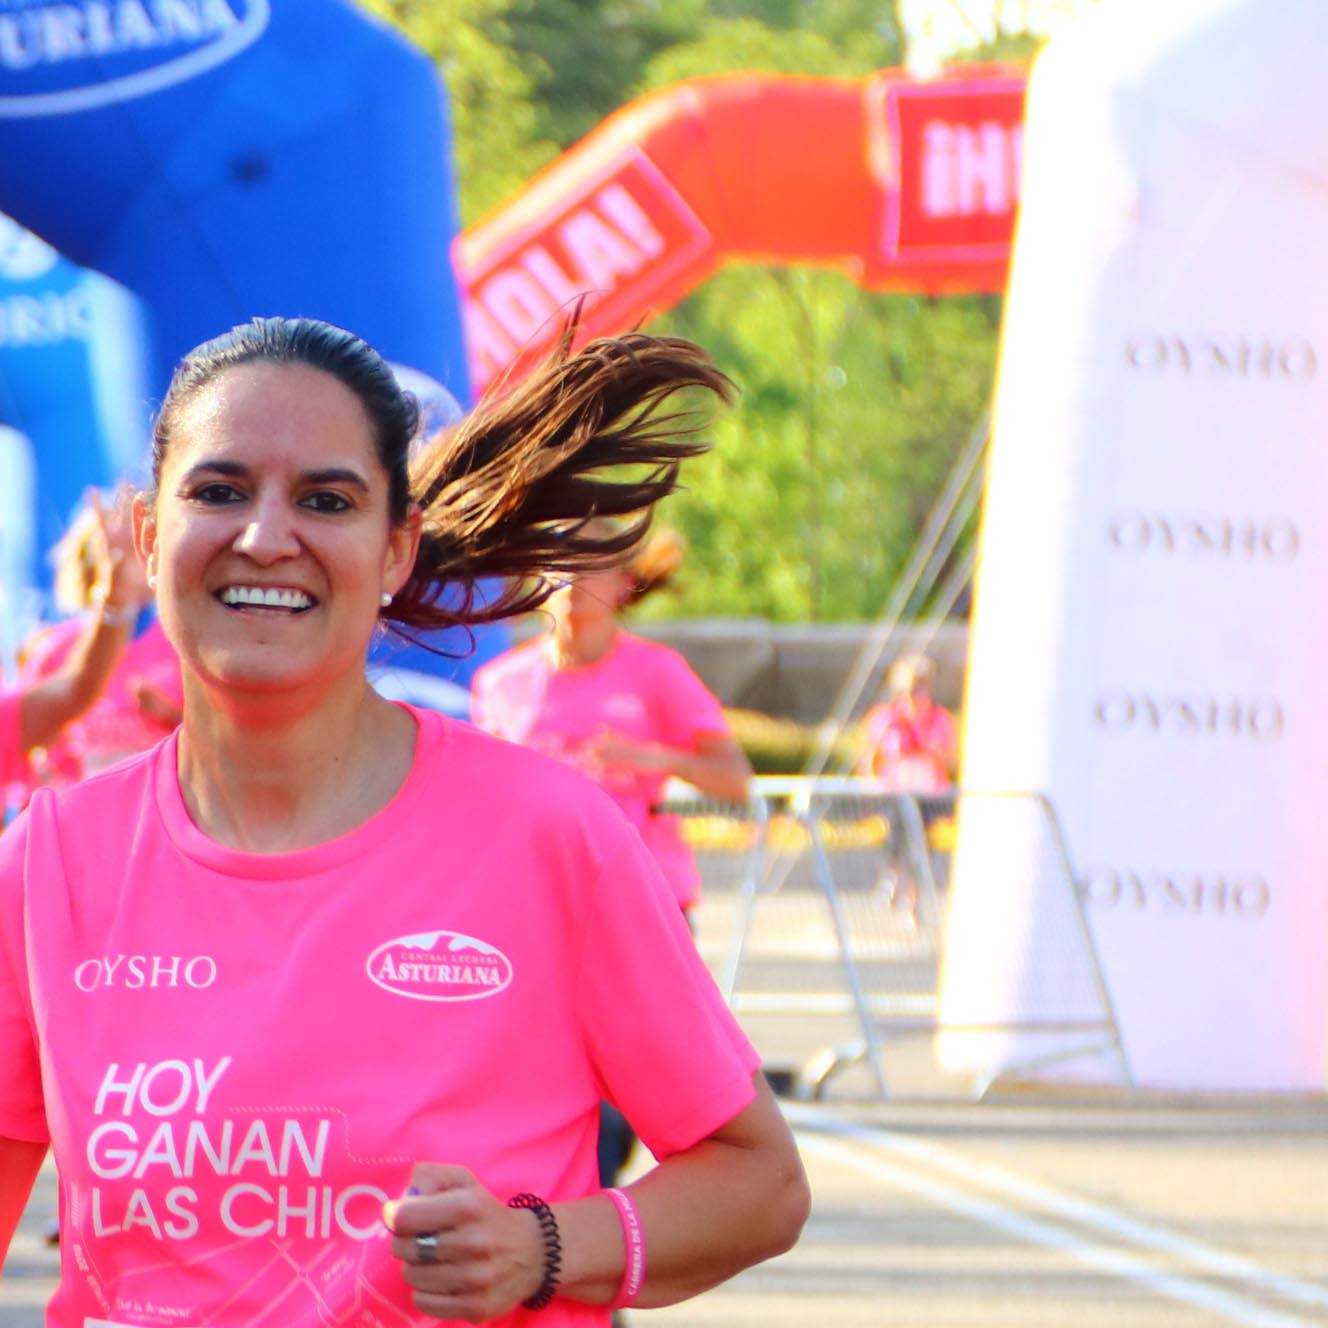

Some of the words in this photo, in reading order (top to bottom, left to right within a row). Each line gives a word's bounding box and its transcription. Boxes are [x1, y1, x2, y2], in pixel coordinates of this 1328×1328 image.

[1124, 334, 1317, 382] OYSHO
[1108, 511, 1301, 563] OYSHO
[1094, 689, 1285, 741] OYSHO
[1081, 867, 1272, 919] OYSHO
[74, 955, 217, 992] OYSHO
[378, 953, 502, 985] ASTURIANA
[94, 1056, 232, 1117] HOY
[86, 1119, 331, 1179] GANAN
[92, 1186, 199, 1241] LAS
[220, 1183, 392, 1241] CHIC
